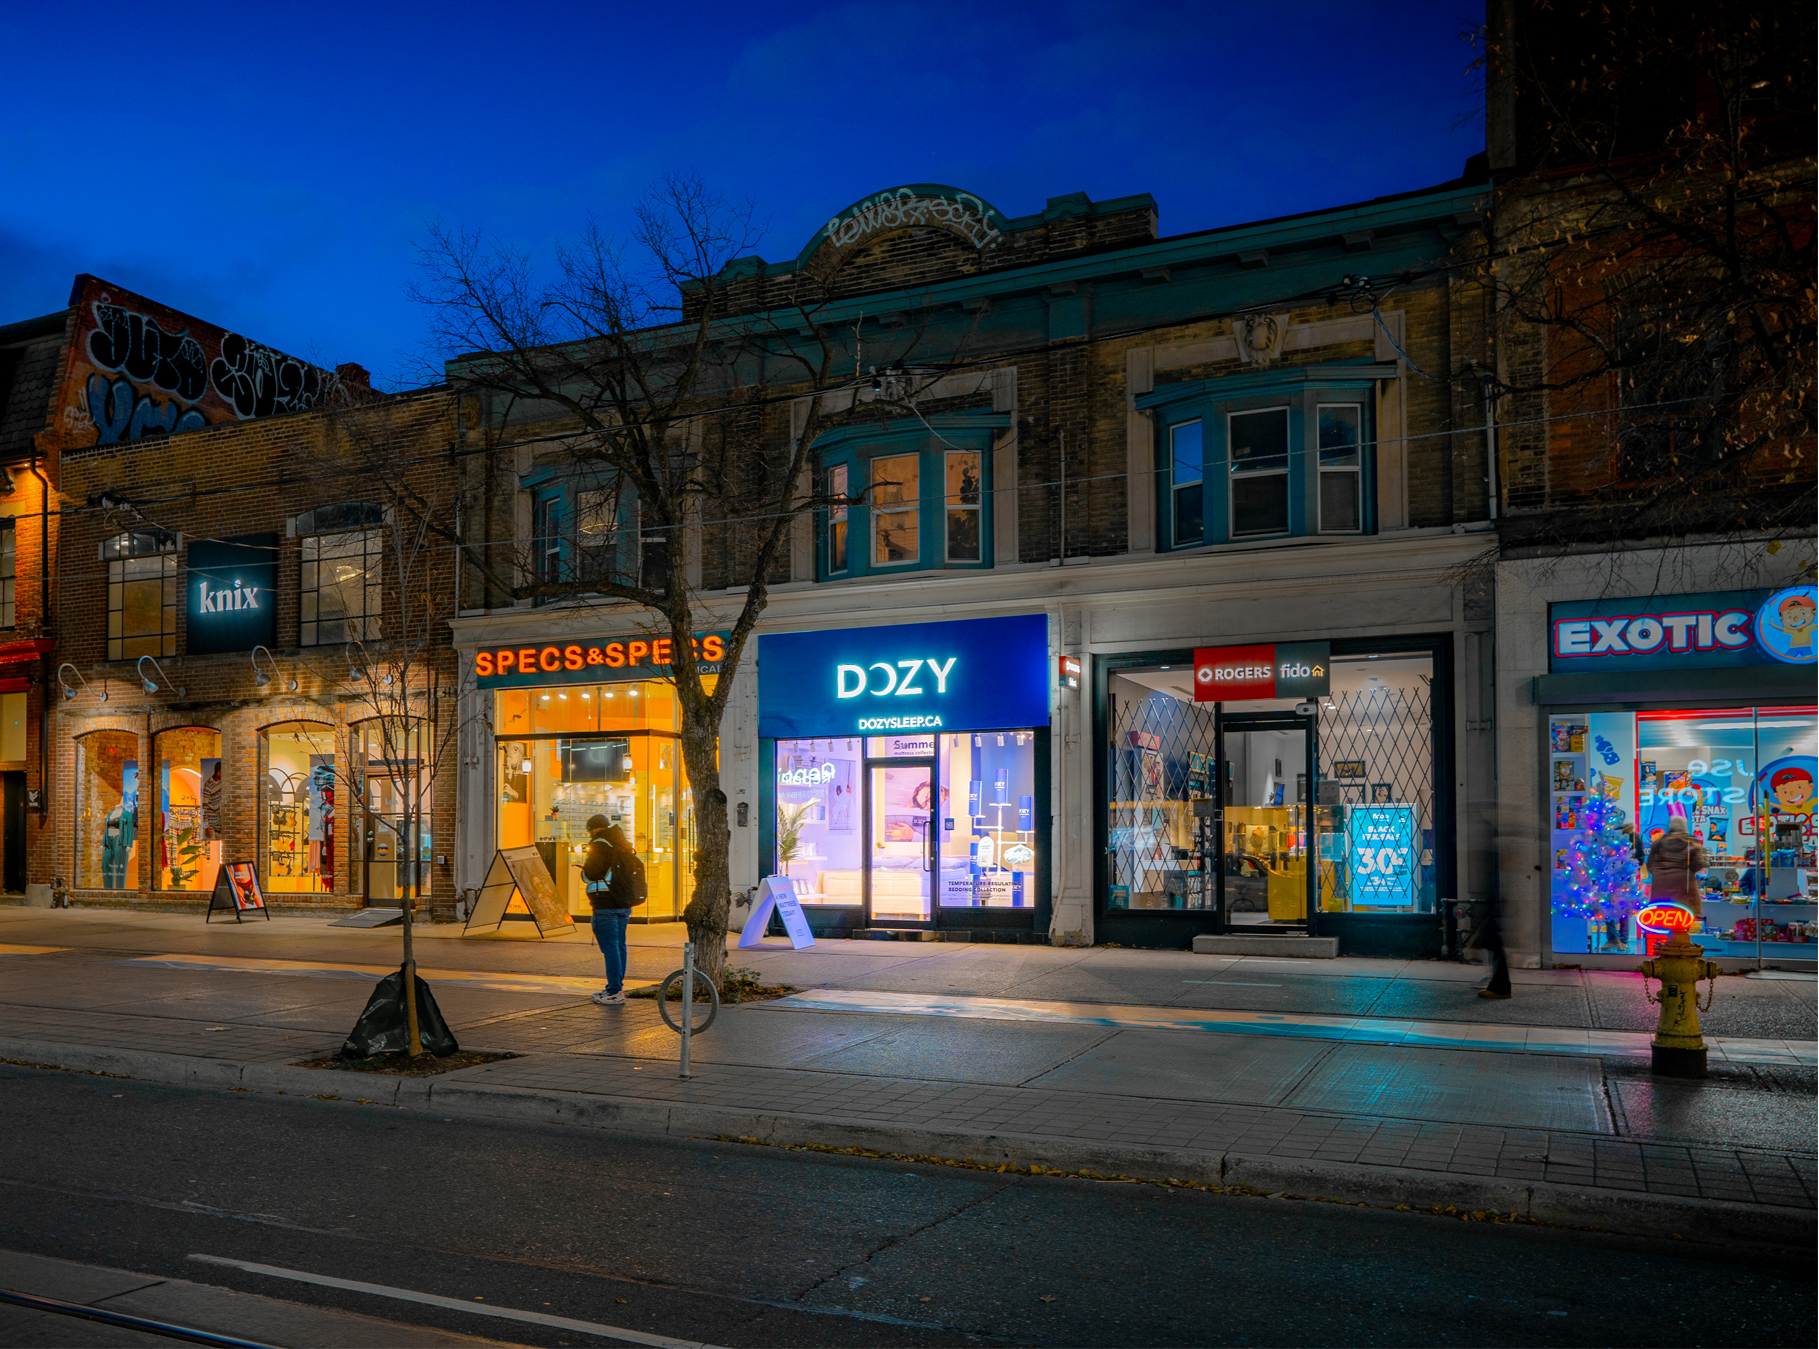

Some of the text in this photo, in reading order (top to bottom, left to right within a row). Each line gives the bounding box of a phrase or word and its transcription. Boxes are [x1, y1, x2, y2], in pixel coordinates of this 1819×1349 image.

[199, 579, 259, 614] knix
[1556, 610, 1753, 656] EXOTIC
[475, 635, 723, 676] SPECS&SPES
[697, 664, 721, 674] ICAL
[1214, 659, 1310, 681] ROGERS fido
[858, 715, 942, 731] DOZYSLEEP.CA
[893, 739, 934, 750] Summe
[1701, 805, 1727, 815] SNAX
[1640, 910, 1689, 927] OPEN
